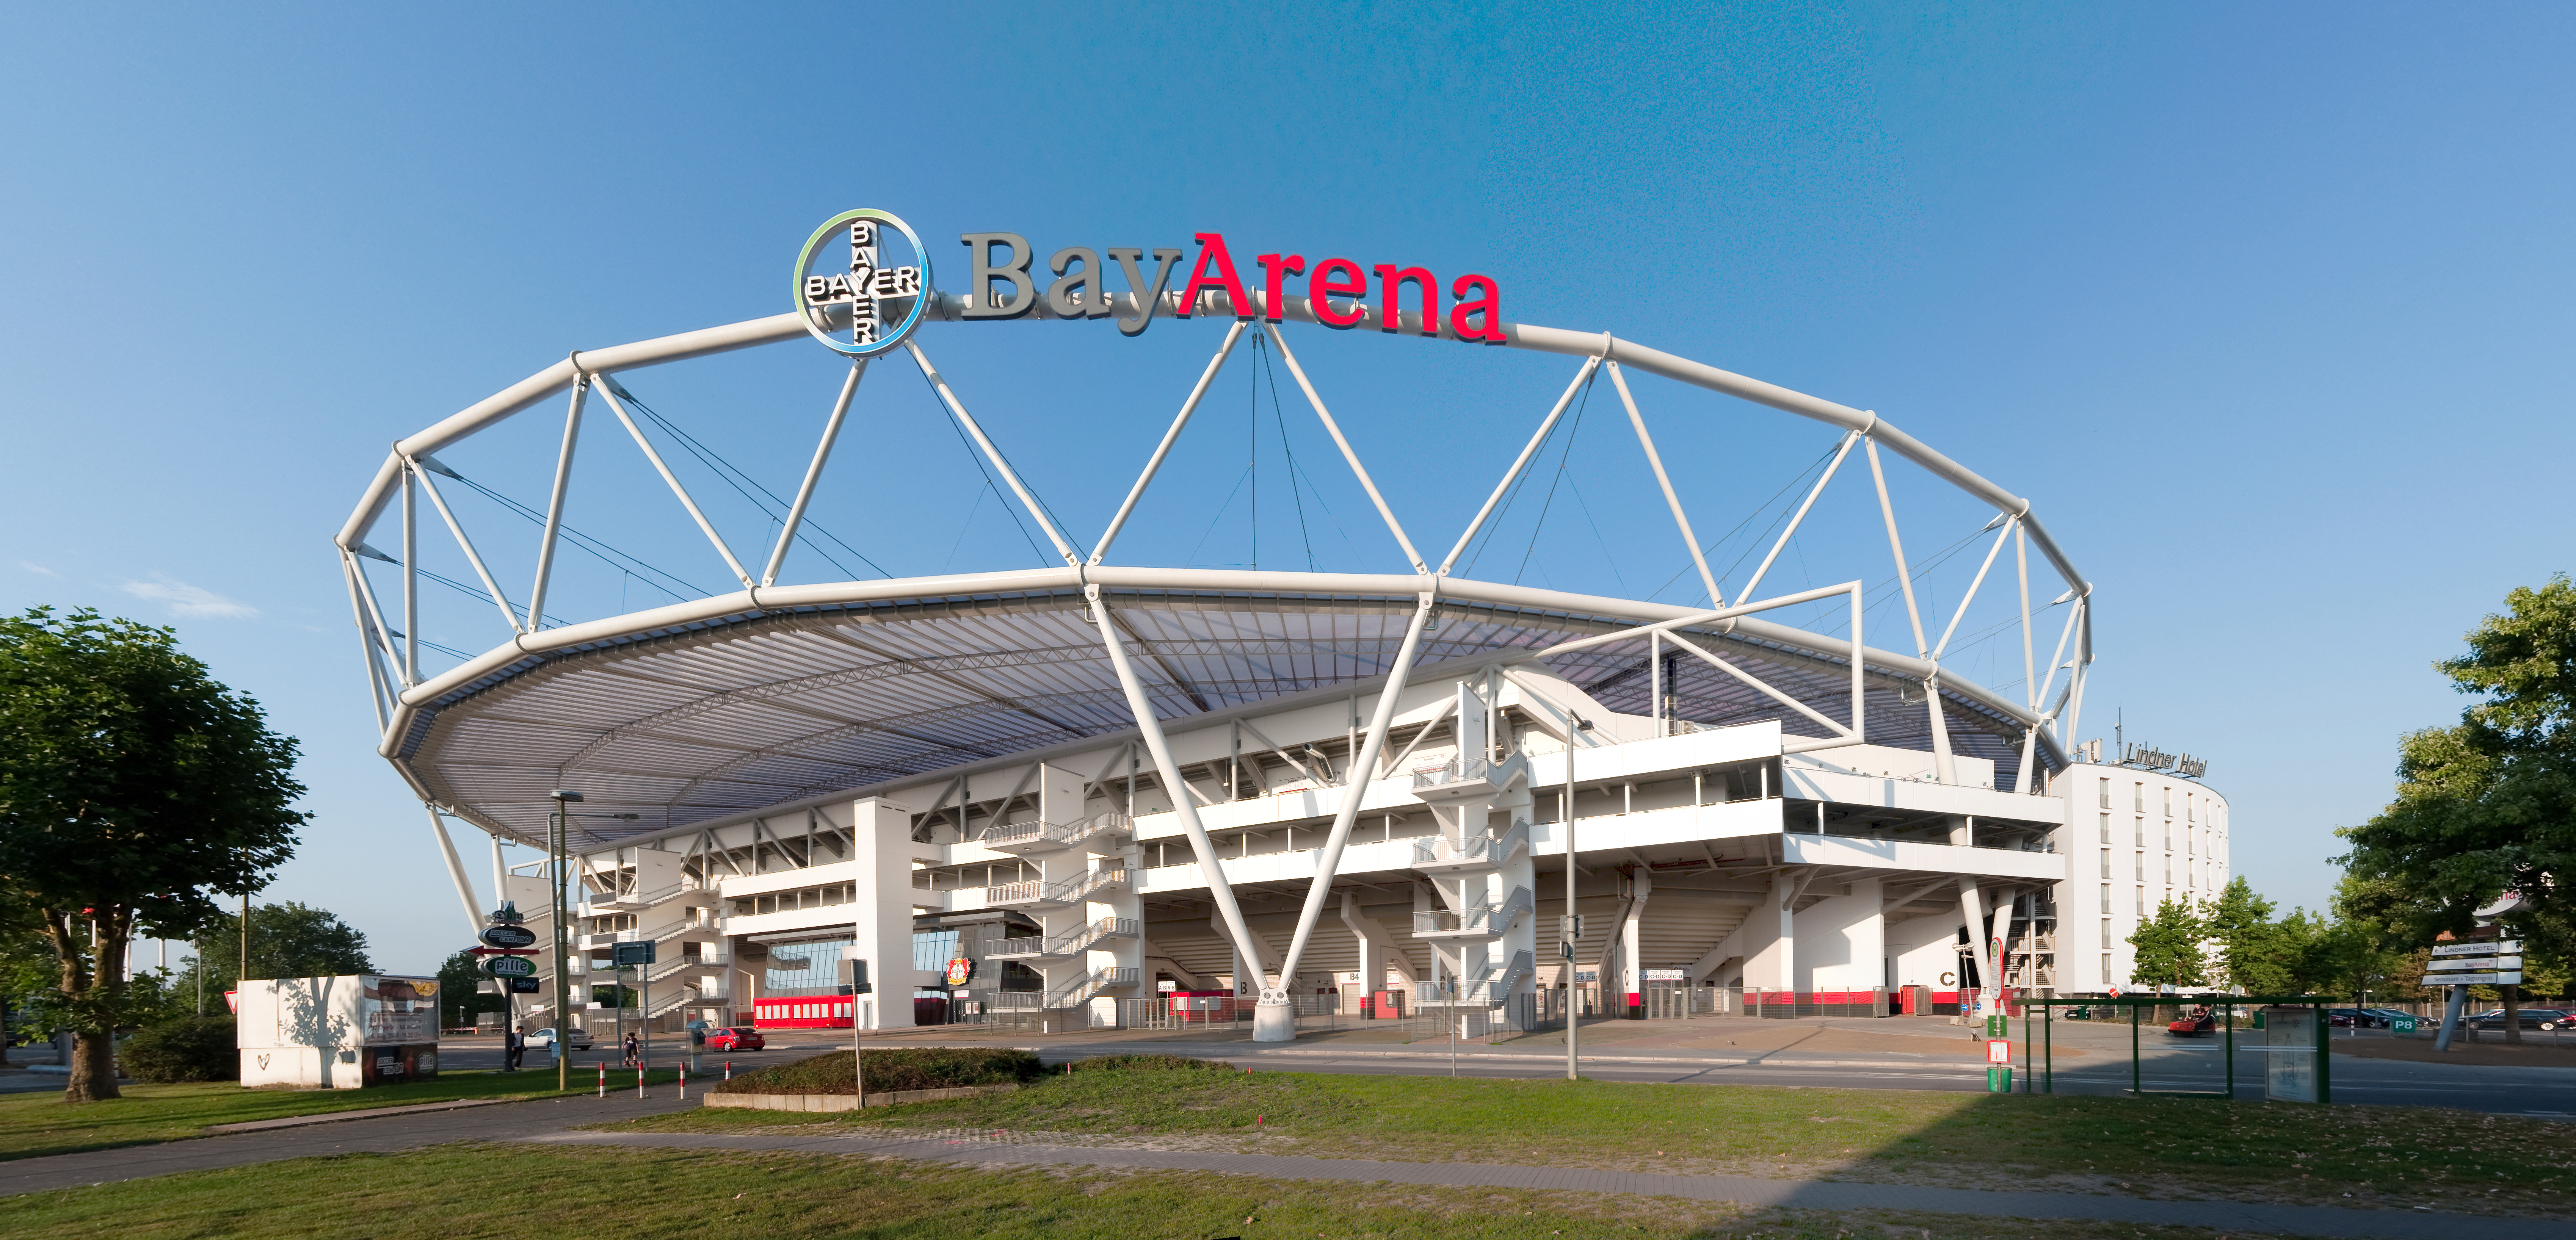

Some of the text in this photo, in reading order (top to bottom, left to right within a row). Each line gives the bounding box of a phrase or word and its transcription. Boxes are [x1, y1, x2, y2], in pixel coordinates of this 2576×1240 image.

[807, 266, 920, 297] BAYER
[850, 223, 874, 341] BAYER
[961, 232, 1507, 344] BayArena
[2123, 742, 2208, 778] Lindner Hotel
[1993, 945, 1997, 954] H
[517, 981, 536, 989] sky
[1625, 970, 1629, 986] C
[1940, 972, 1955, 986] C
[1241, 982, 1247, 994] B
